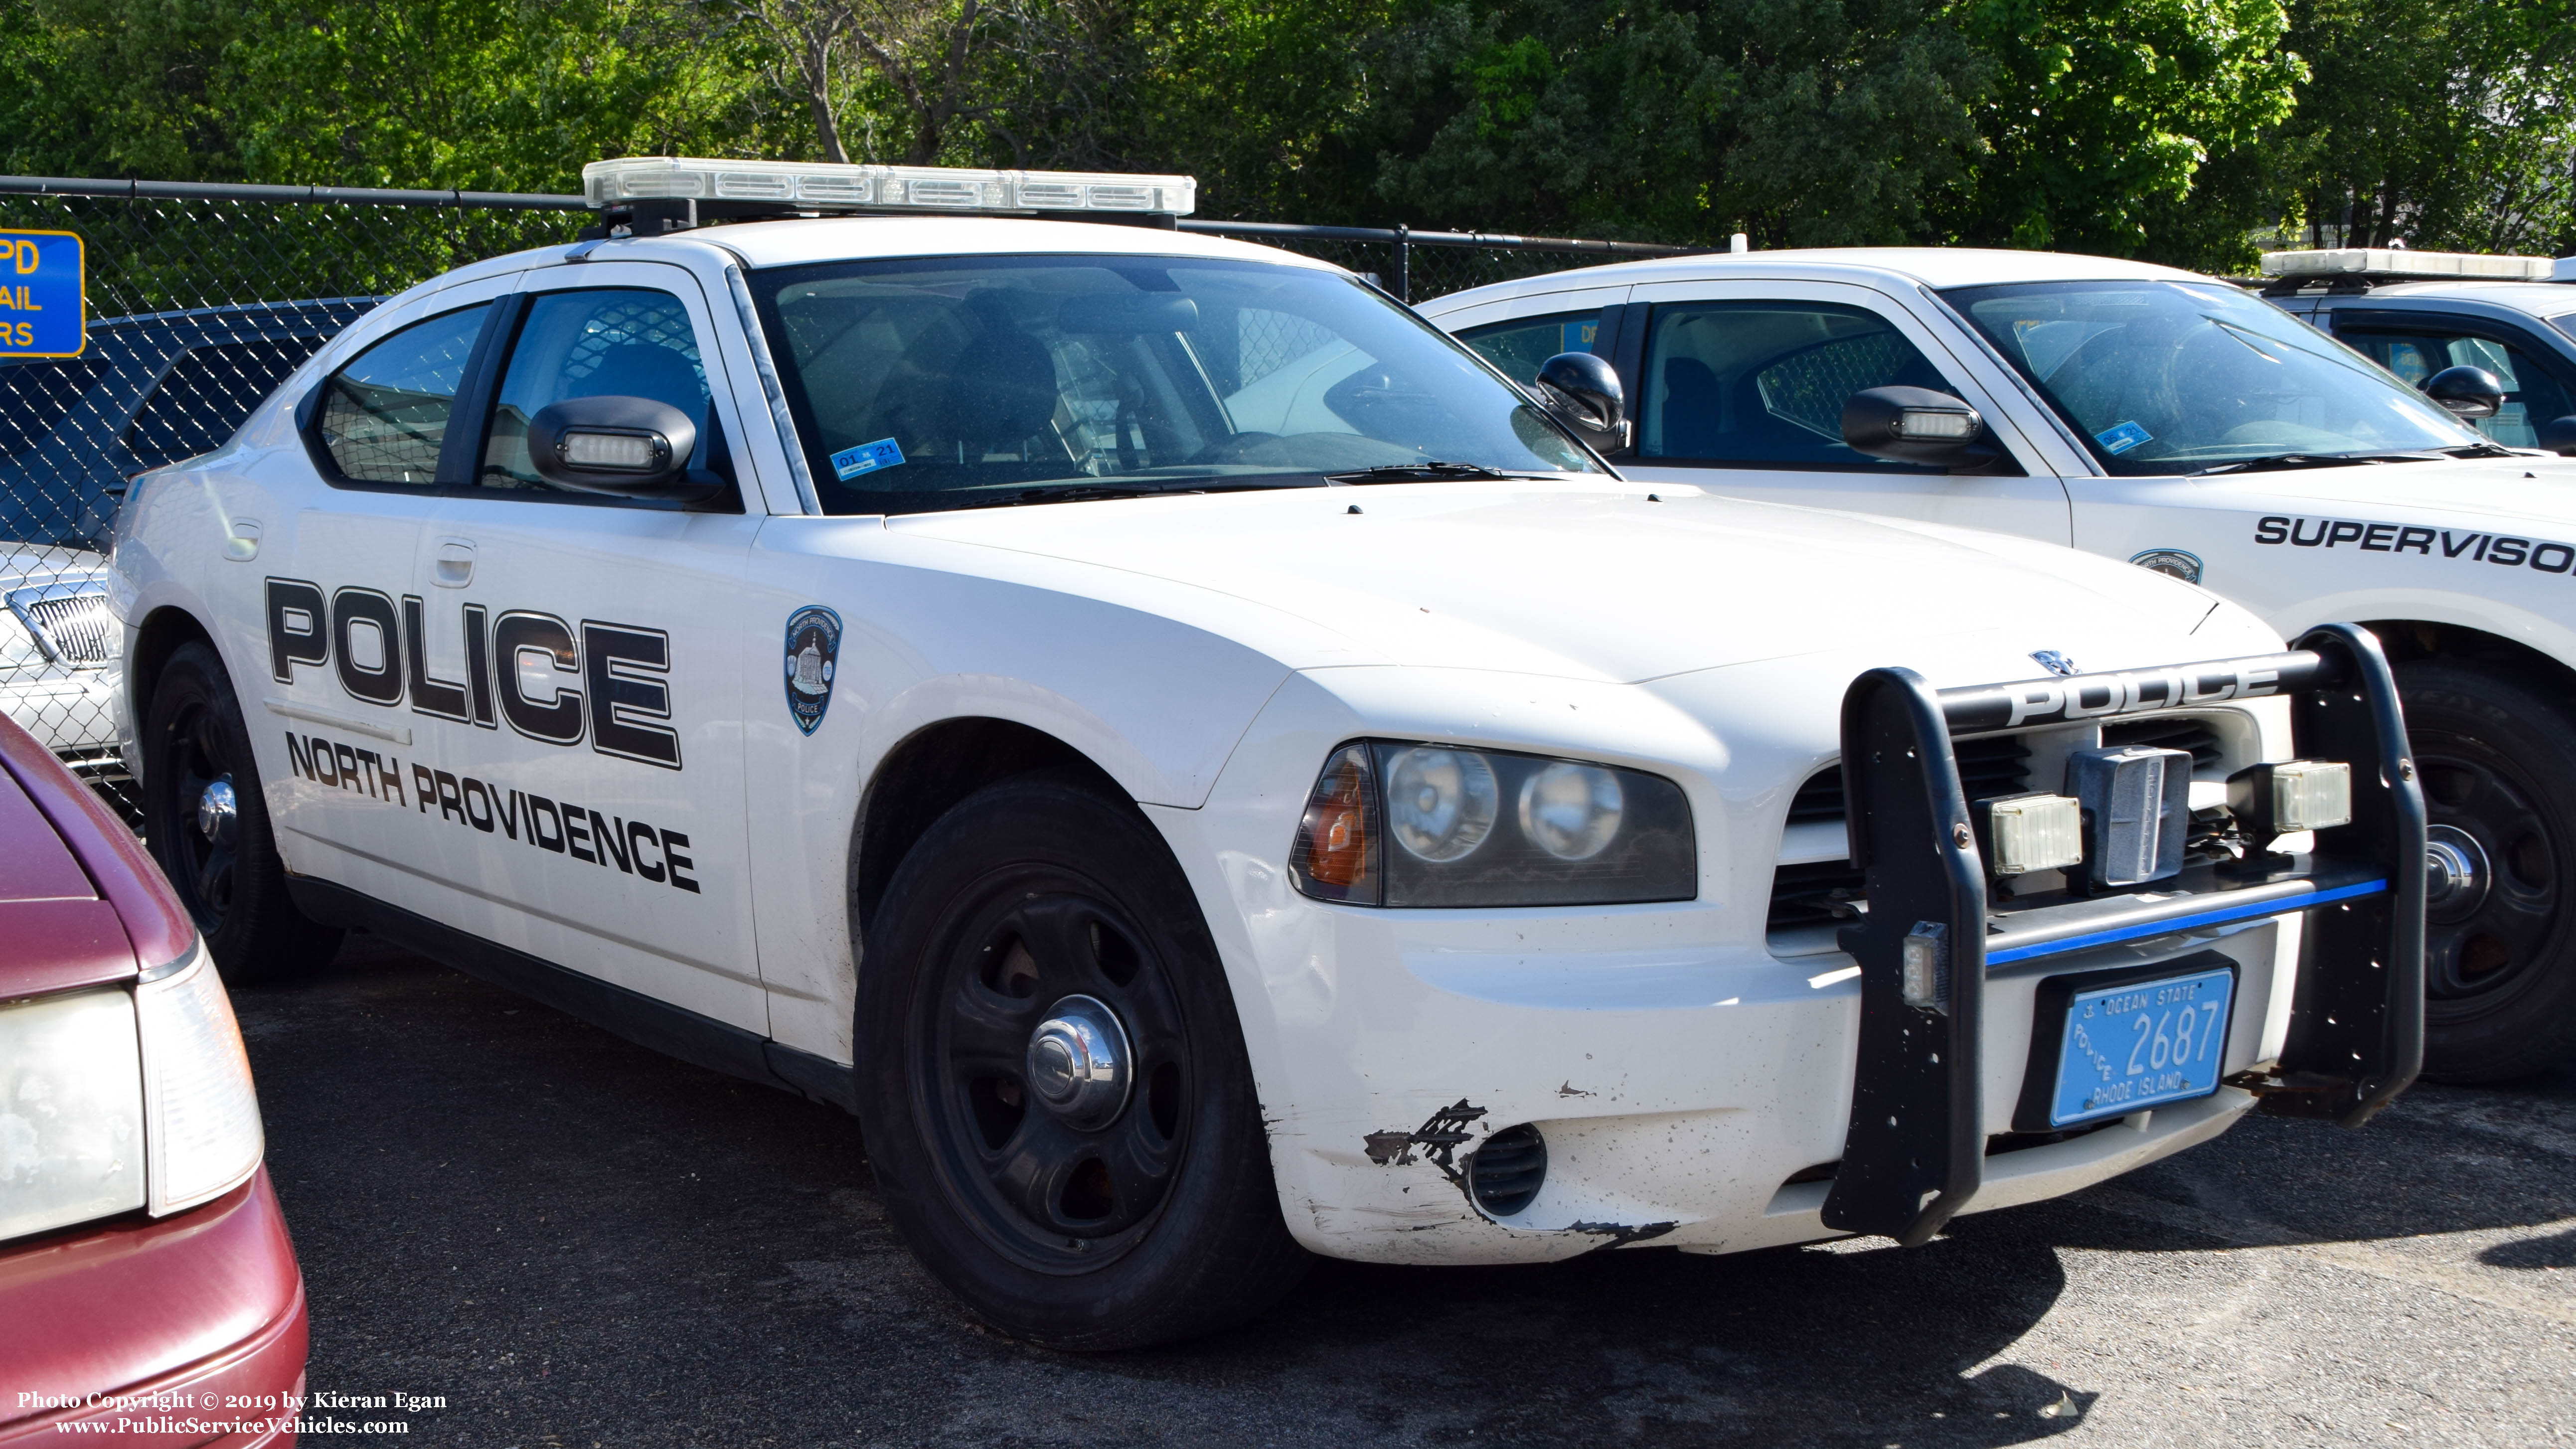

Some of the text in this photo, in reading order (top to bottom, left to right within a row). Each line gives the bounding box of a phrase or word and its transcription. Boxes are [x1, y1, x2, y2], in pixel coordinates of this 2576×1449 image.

[839, 454, 858, 467] 01
[876, 444, 895, 457] 21
[2158, 557, 2192, 575] PROVIDENCE
[2254, 516, 2576, 576] SUPERVISO
[792, 616, 834, 641] NORTH PROVIDENCE
[265, 576, 682, 771] POLICE
[2002, 662, 2279, 726] POLICE
[798, 702, 818, 713] POLICE
[286, 731, 701, 894] NORTH PROVIDENCE
[2105, 984, 2196, 1015] OCEAN STATE
[2074, 1023, 2112, 1081] POLICE
[2126, 1000, 2219, 1076] 2687
[2093, 1071, 2182, 1105] RHODE ISLAND
